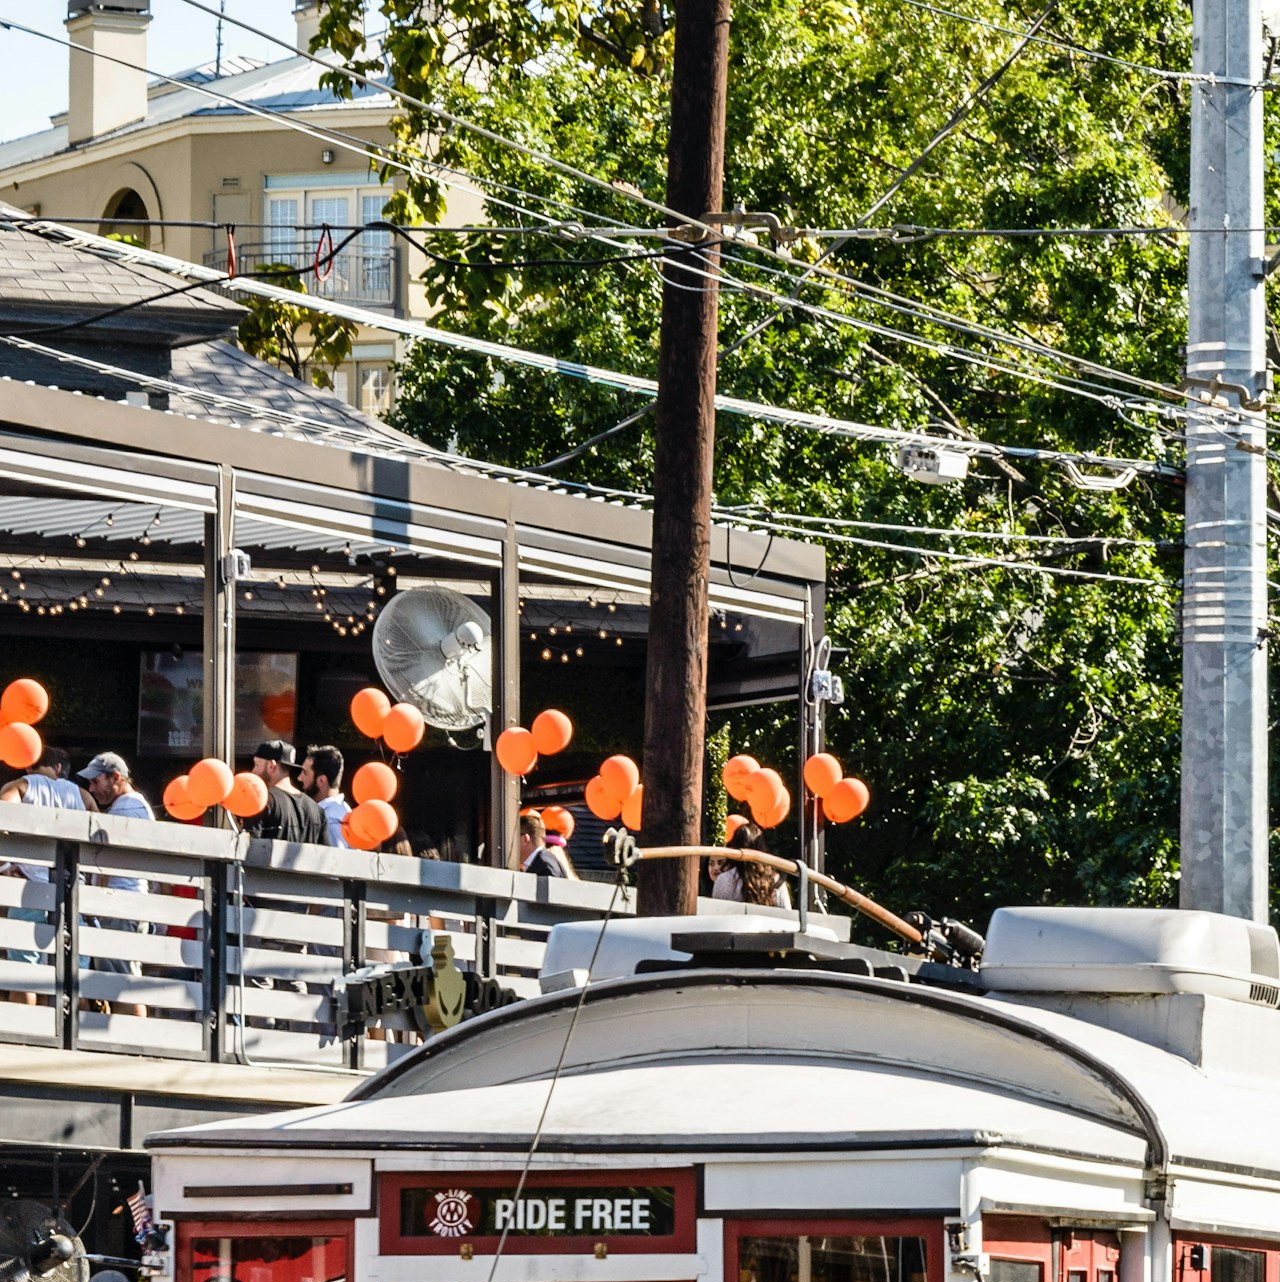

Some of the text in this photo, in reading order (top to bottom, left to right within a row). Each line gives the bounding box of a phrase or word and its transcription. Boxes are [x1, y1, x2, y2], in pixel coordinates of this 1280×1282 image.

[361, 970, 527, 1017] NEXT DOO
[429, 1218, 473, 1237] TROLLEY
[495, 1199, 651, 1230] RIDE FREE
